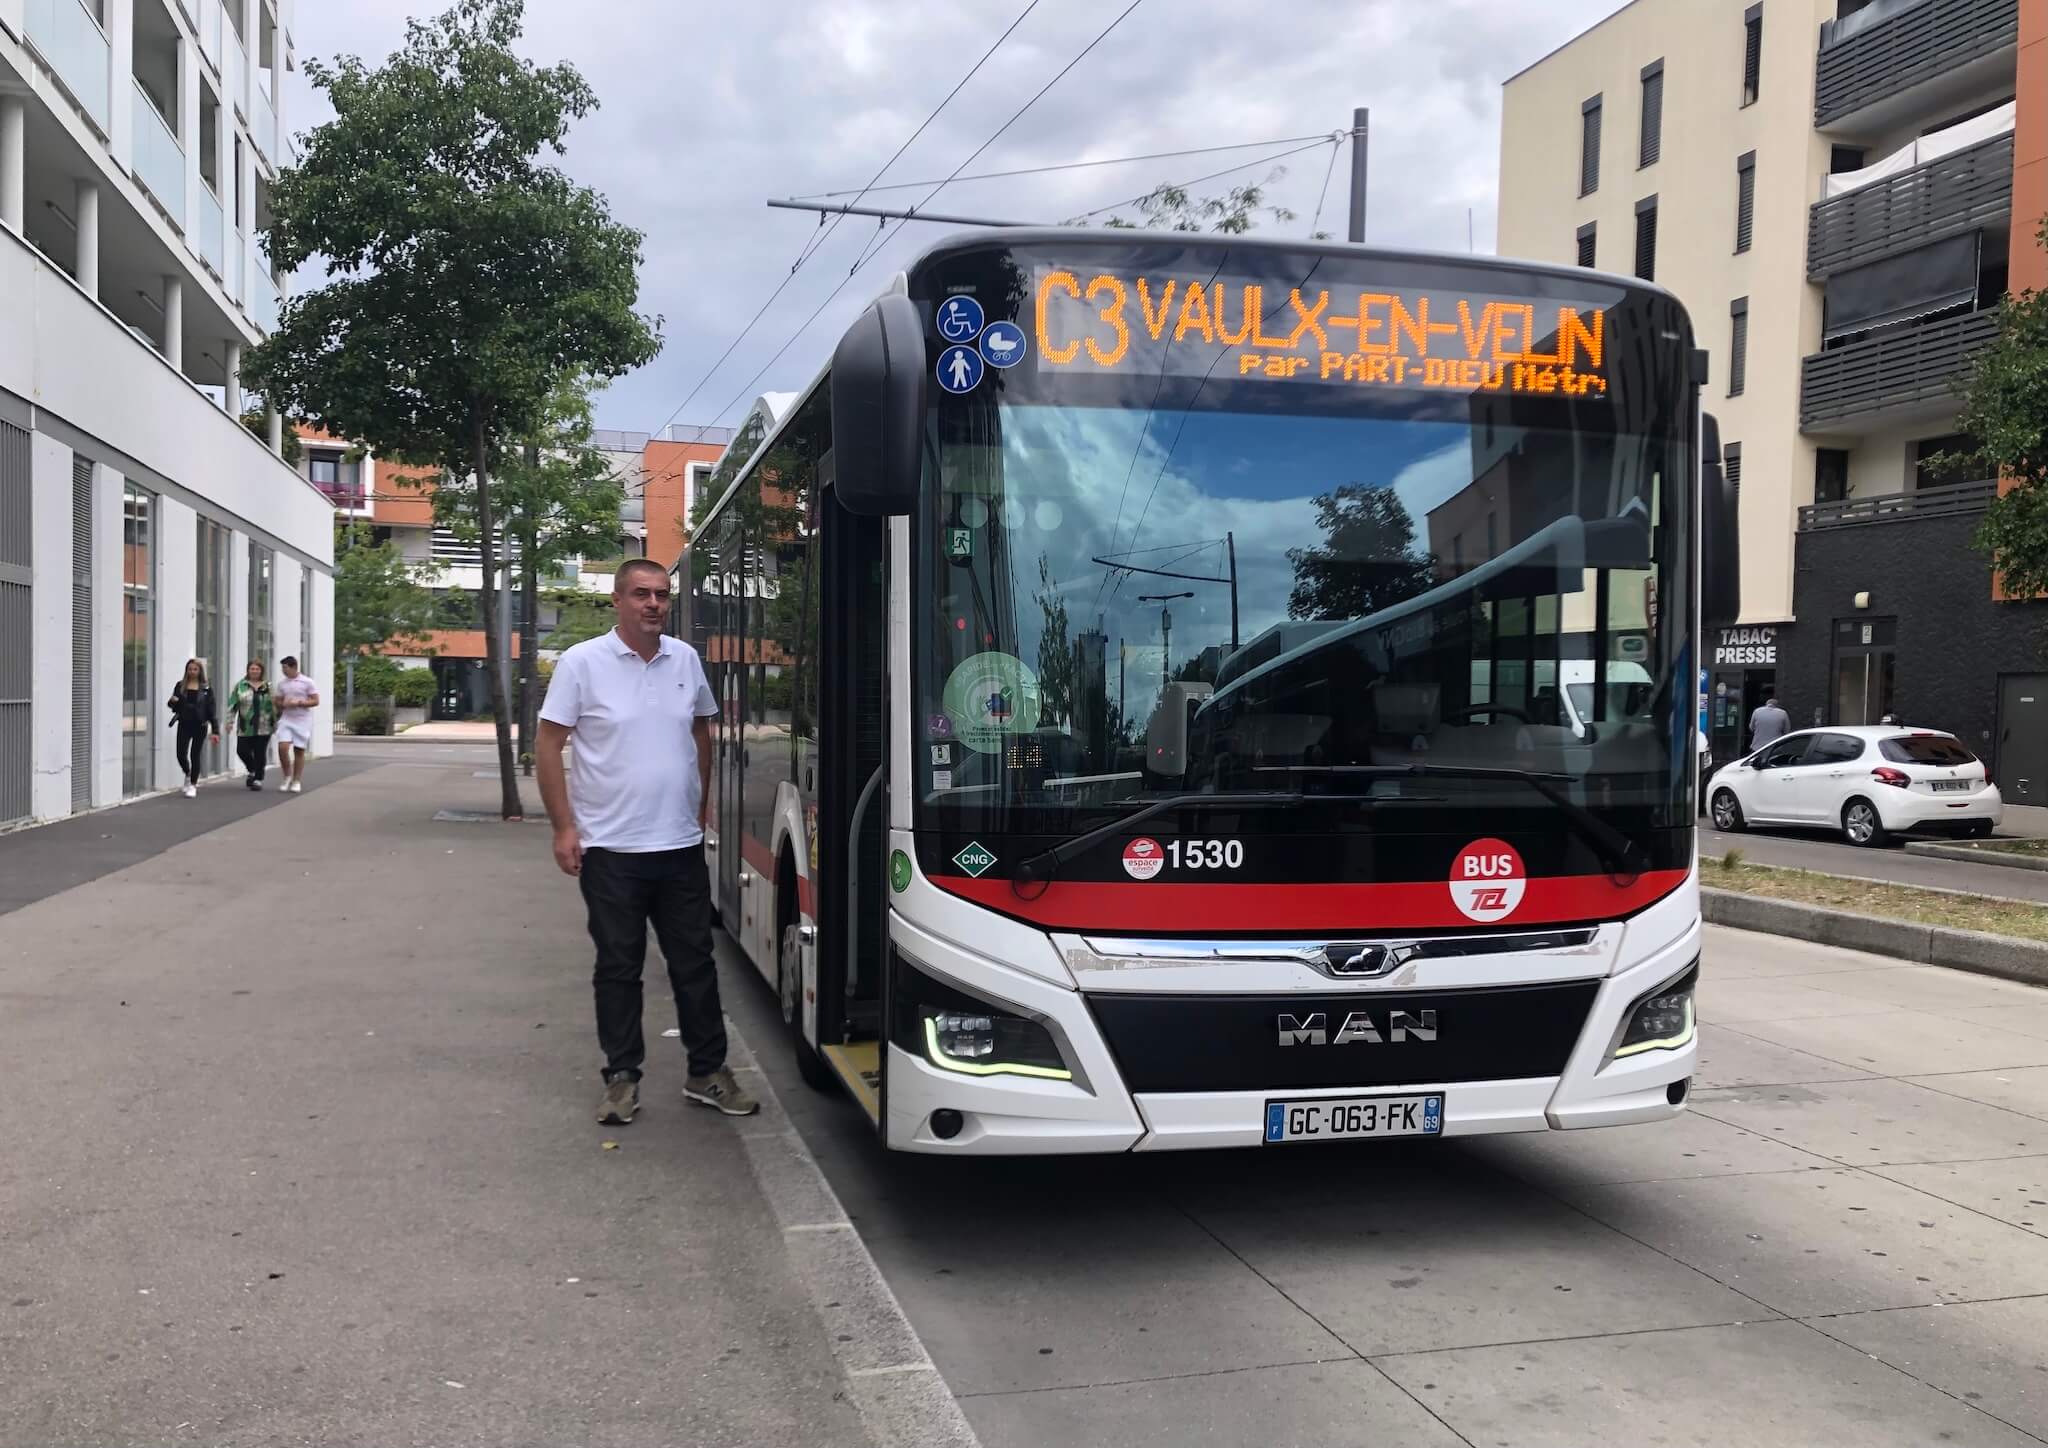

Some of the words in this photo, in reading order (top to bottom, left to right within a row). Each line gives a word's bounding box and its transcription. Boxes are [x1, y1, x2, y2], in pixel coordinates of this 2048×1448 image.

[1036, 272, 1129, 367] C3
[1137, 277, 1605, 368] VAULX-EN-VELIN
[1239, 354, 1310, 377] par
[1319, 352, 1504, 390] PART-DIEU
[1720, 628, 1772, 646] TABAC
[1715, 646, 1777, 664] PRESSE
[961, 854, 989, 866] CNG
[1166, 839, 1244, 869] 1530
[1463, 854, 1513, 877] BUS
[1277, 1009, 1438, 1047] MAN
[1271, 1125, 1279, 1135] F
[1289, 1102, 1419, 1136] GC-063-FK
[1423, 1115, 1438, 1130] 69
